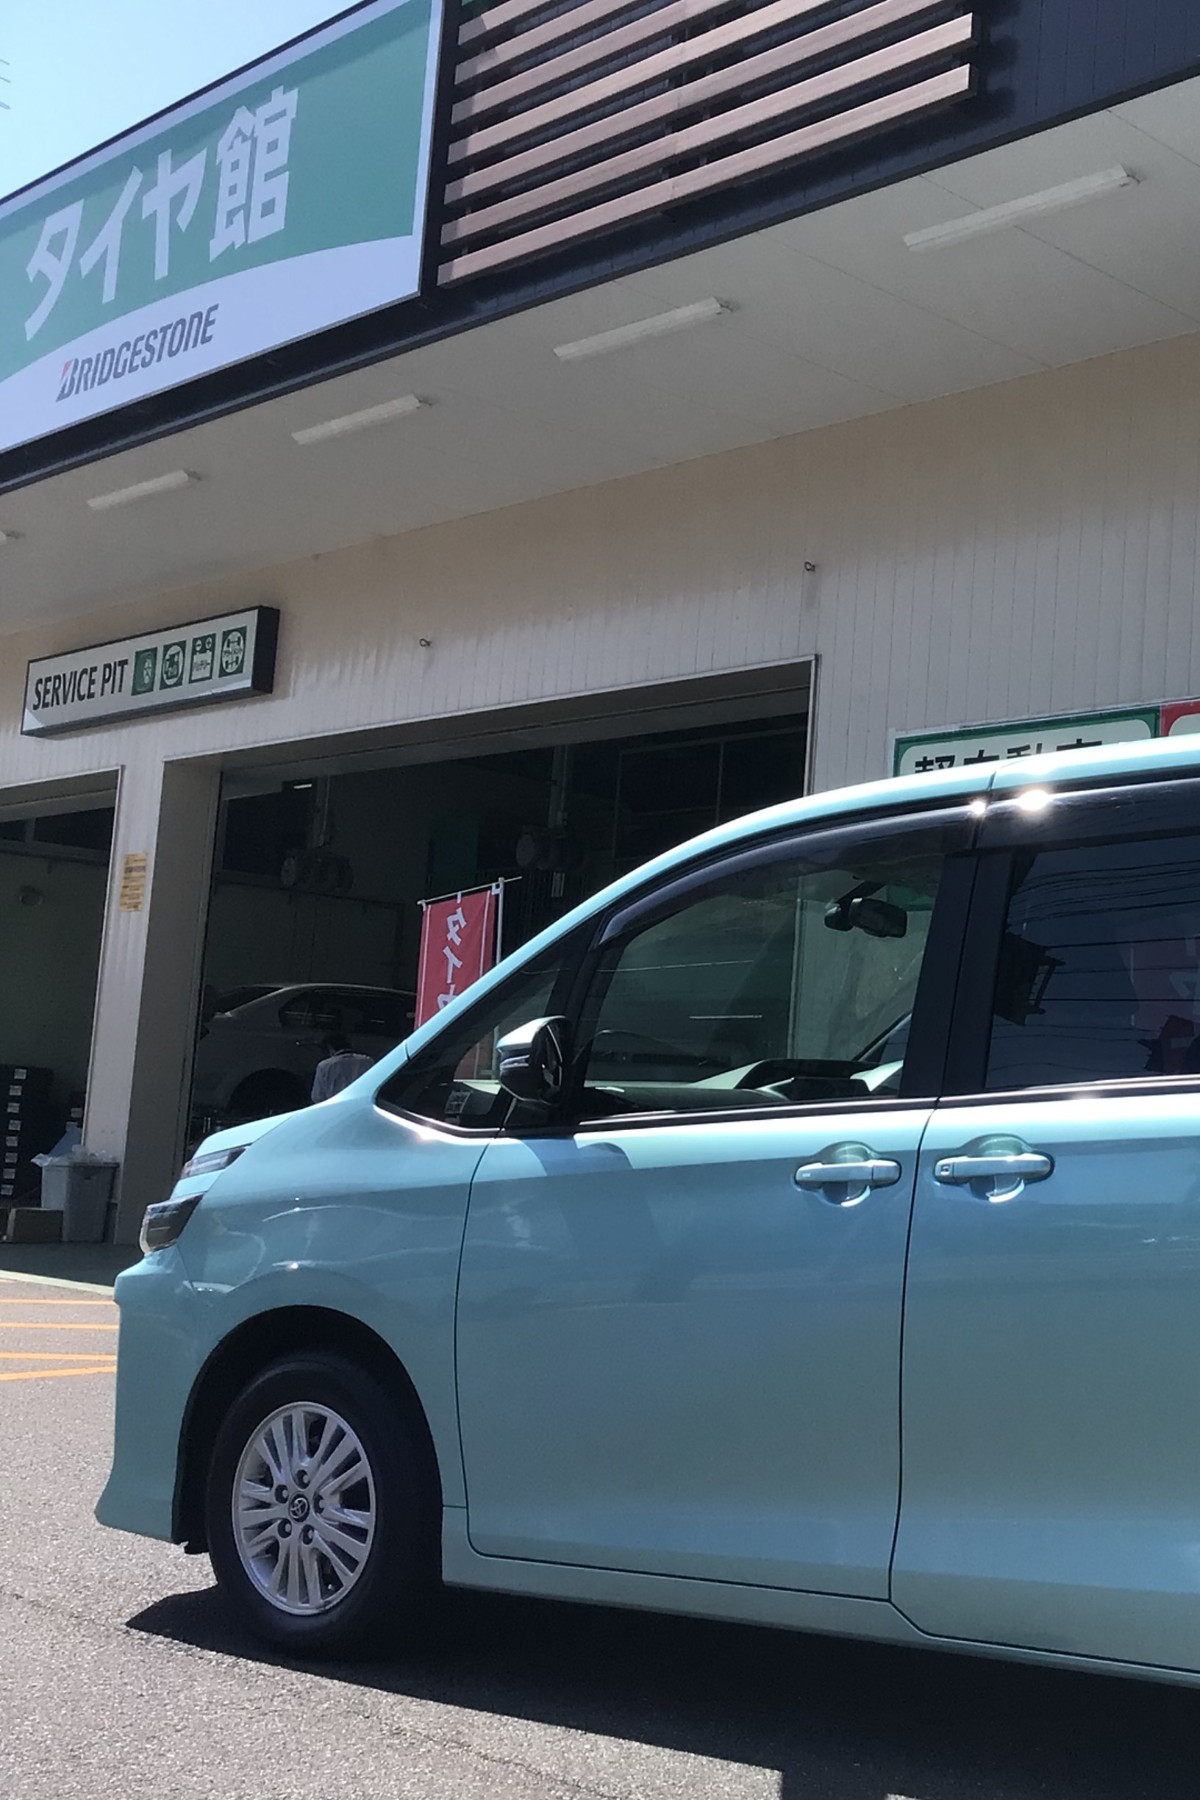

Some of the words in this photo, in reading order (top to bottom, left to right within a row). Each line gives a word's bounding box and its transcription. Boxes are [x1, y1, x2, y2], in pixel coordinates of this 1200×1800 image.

[25, 85, 299, 341] タイヤ館
[56, 303, 219, 402] BRIDGESTONE
[32, 665, 98, 711] SERVICE
[100, 659, 129, 697] PIT
